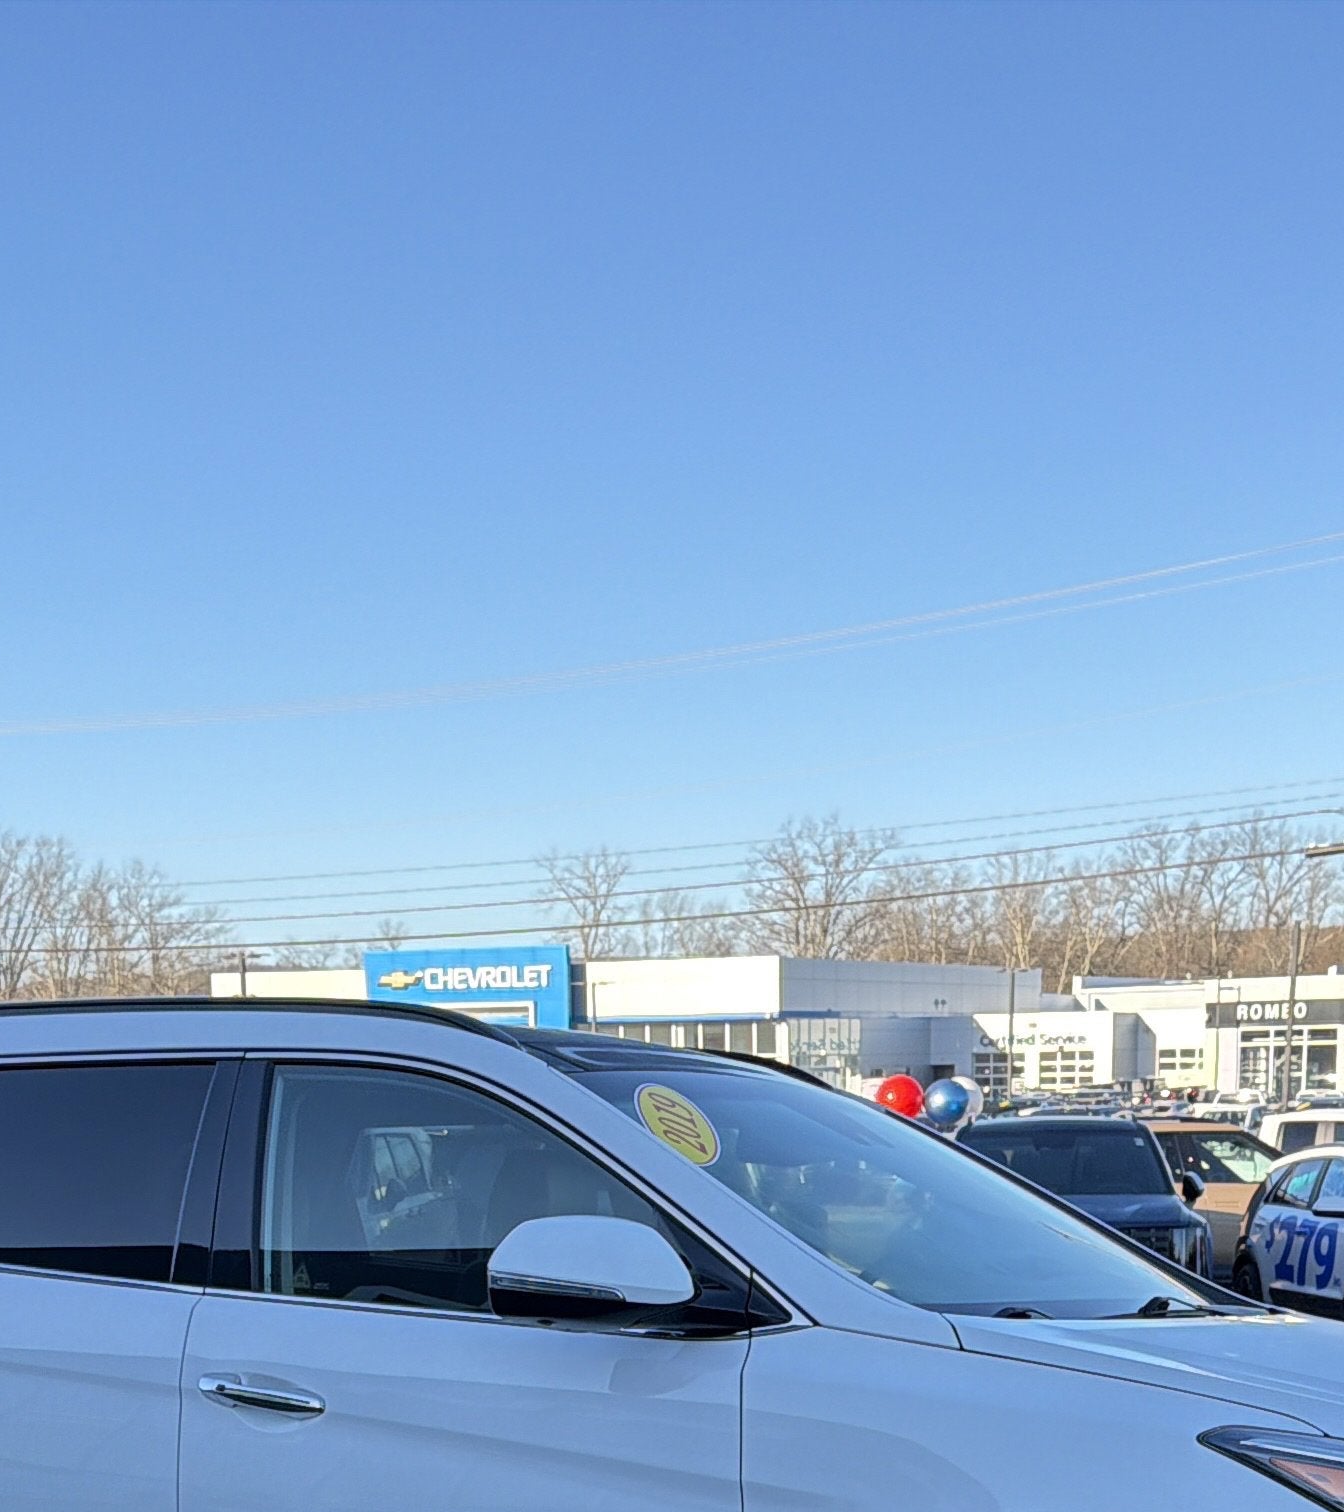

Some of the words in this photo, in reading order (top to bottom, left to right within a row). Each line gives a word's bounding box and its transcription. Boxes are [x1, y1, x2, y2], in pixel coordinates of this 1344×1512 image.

[424, 964, 553, 990] CHEVROLET
[1236, 1001, 1308, 1021] ROMEO
[647, 1092, 709, 1156] 2019
[1264, 1212, 1339, 1291] $279
